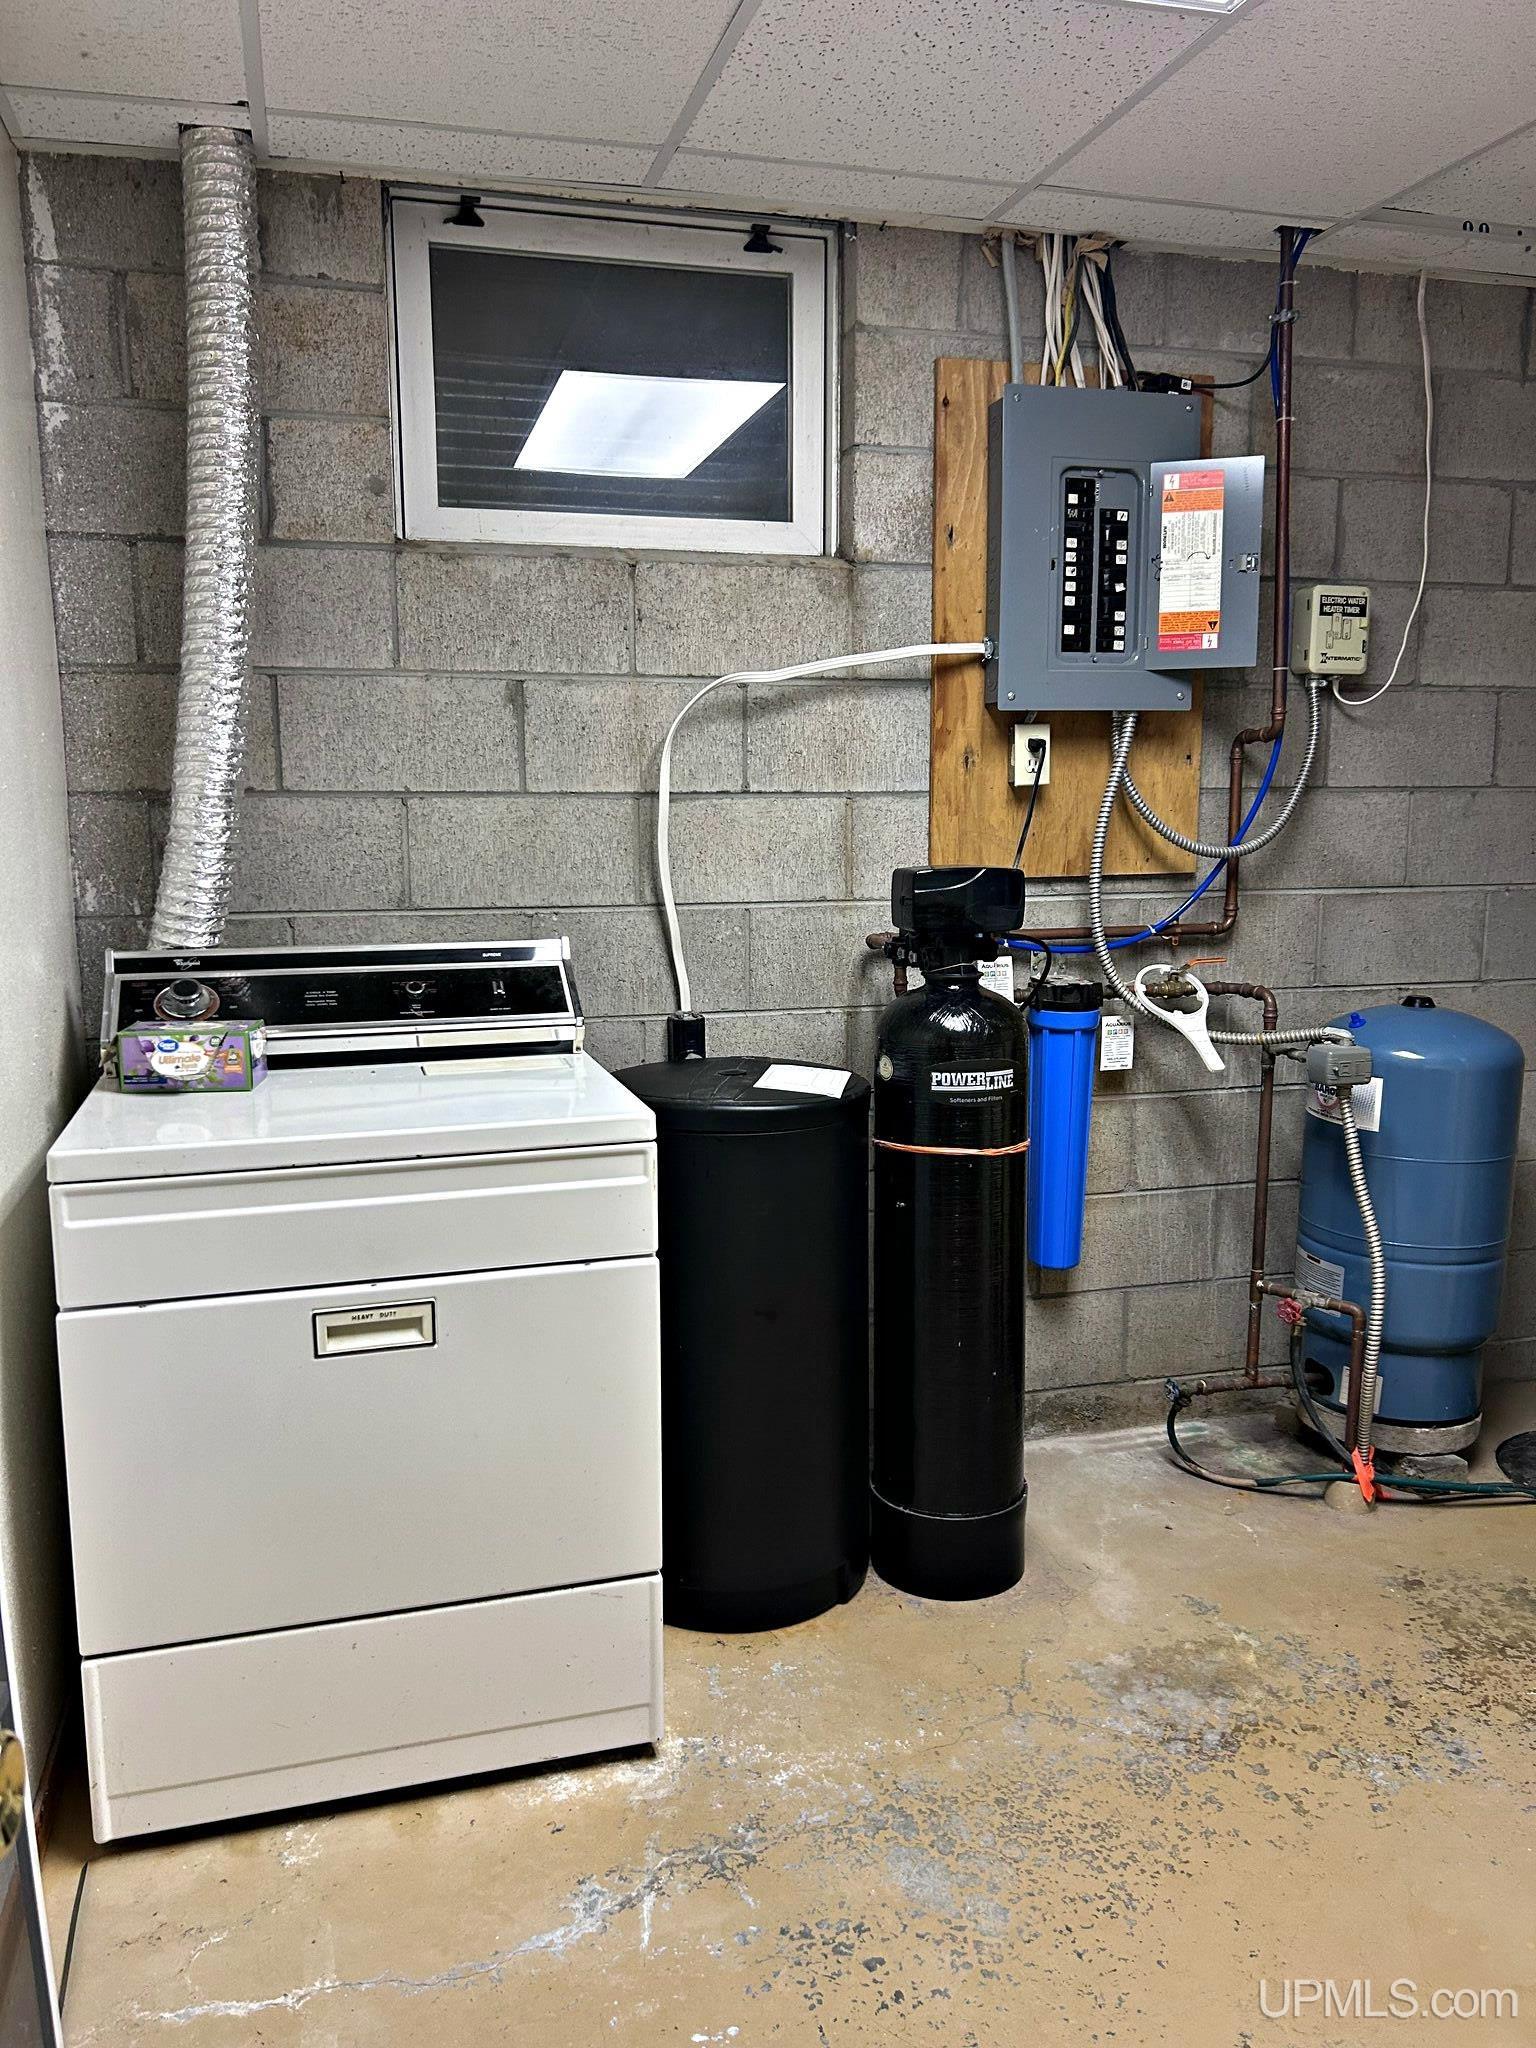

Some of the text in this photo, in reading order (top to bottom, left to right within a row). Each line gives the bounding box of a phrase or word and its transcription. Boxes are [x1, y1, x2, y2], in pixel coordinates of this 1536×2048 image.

[1321, 596, 1366, 605] ELECTRIC WATER
[1323, 605, 1361, 614] HEATER TIMER
